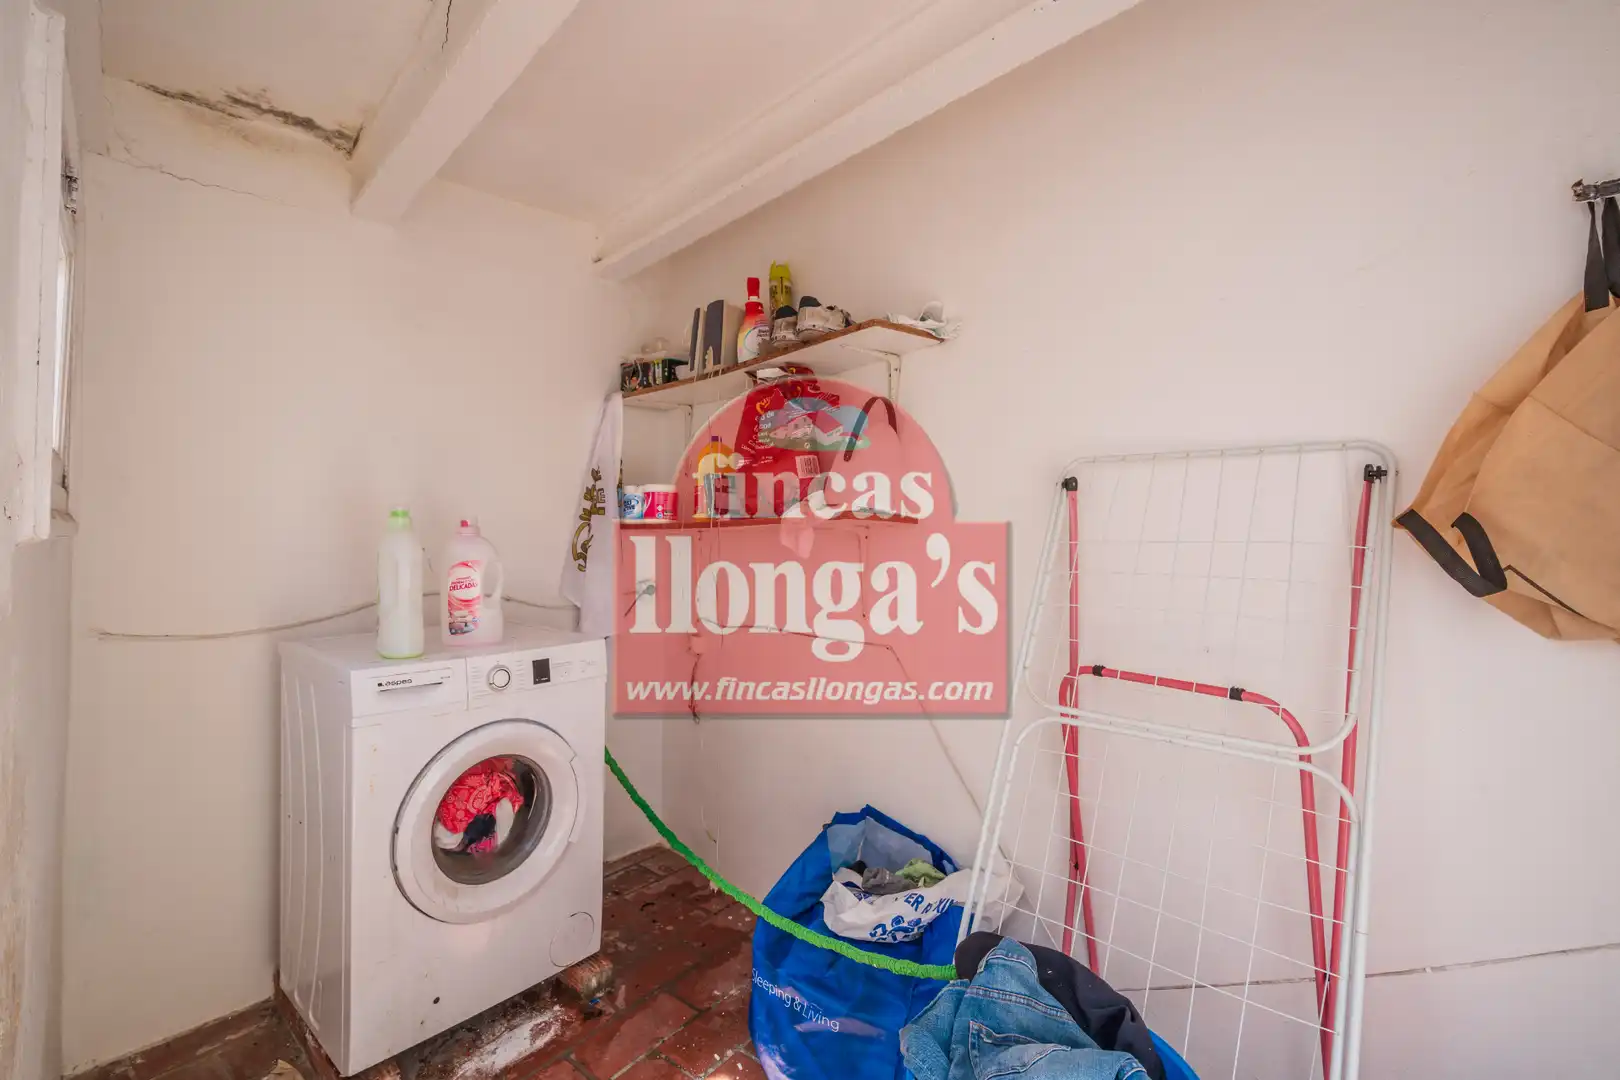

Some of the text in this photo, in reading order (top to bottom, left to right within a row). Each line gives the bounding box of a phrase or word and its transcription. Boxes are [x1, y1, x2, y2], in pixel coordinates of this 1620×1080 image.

[751, 968, 840, 1032] Sleeping & Living
